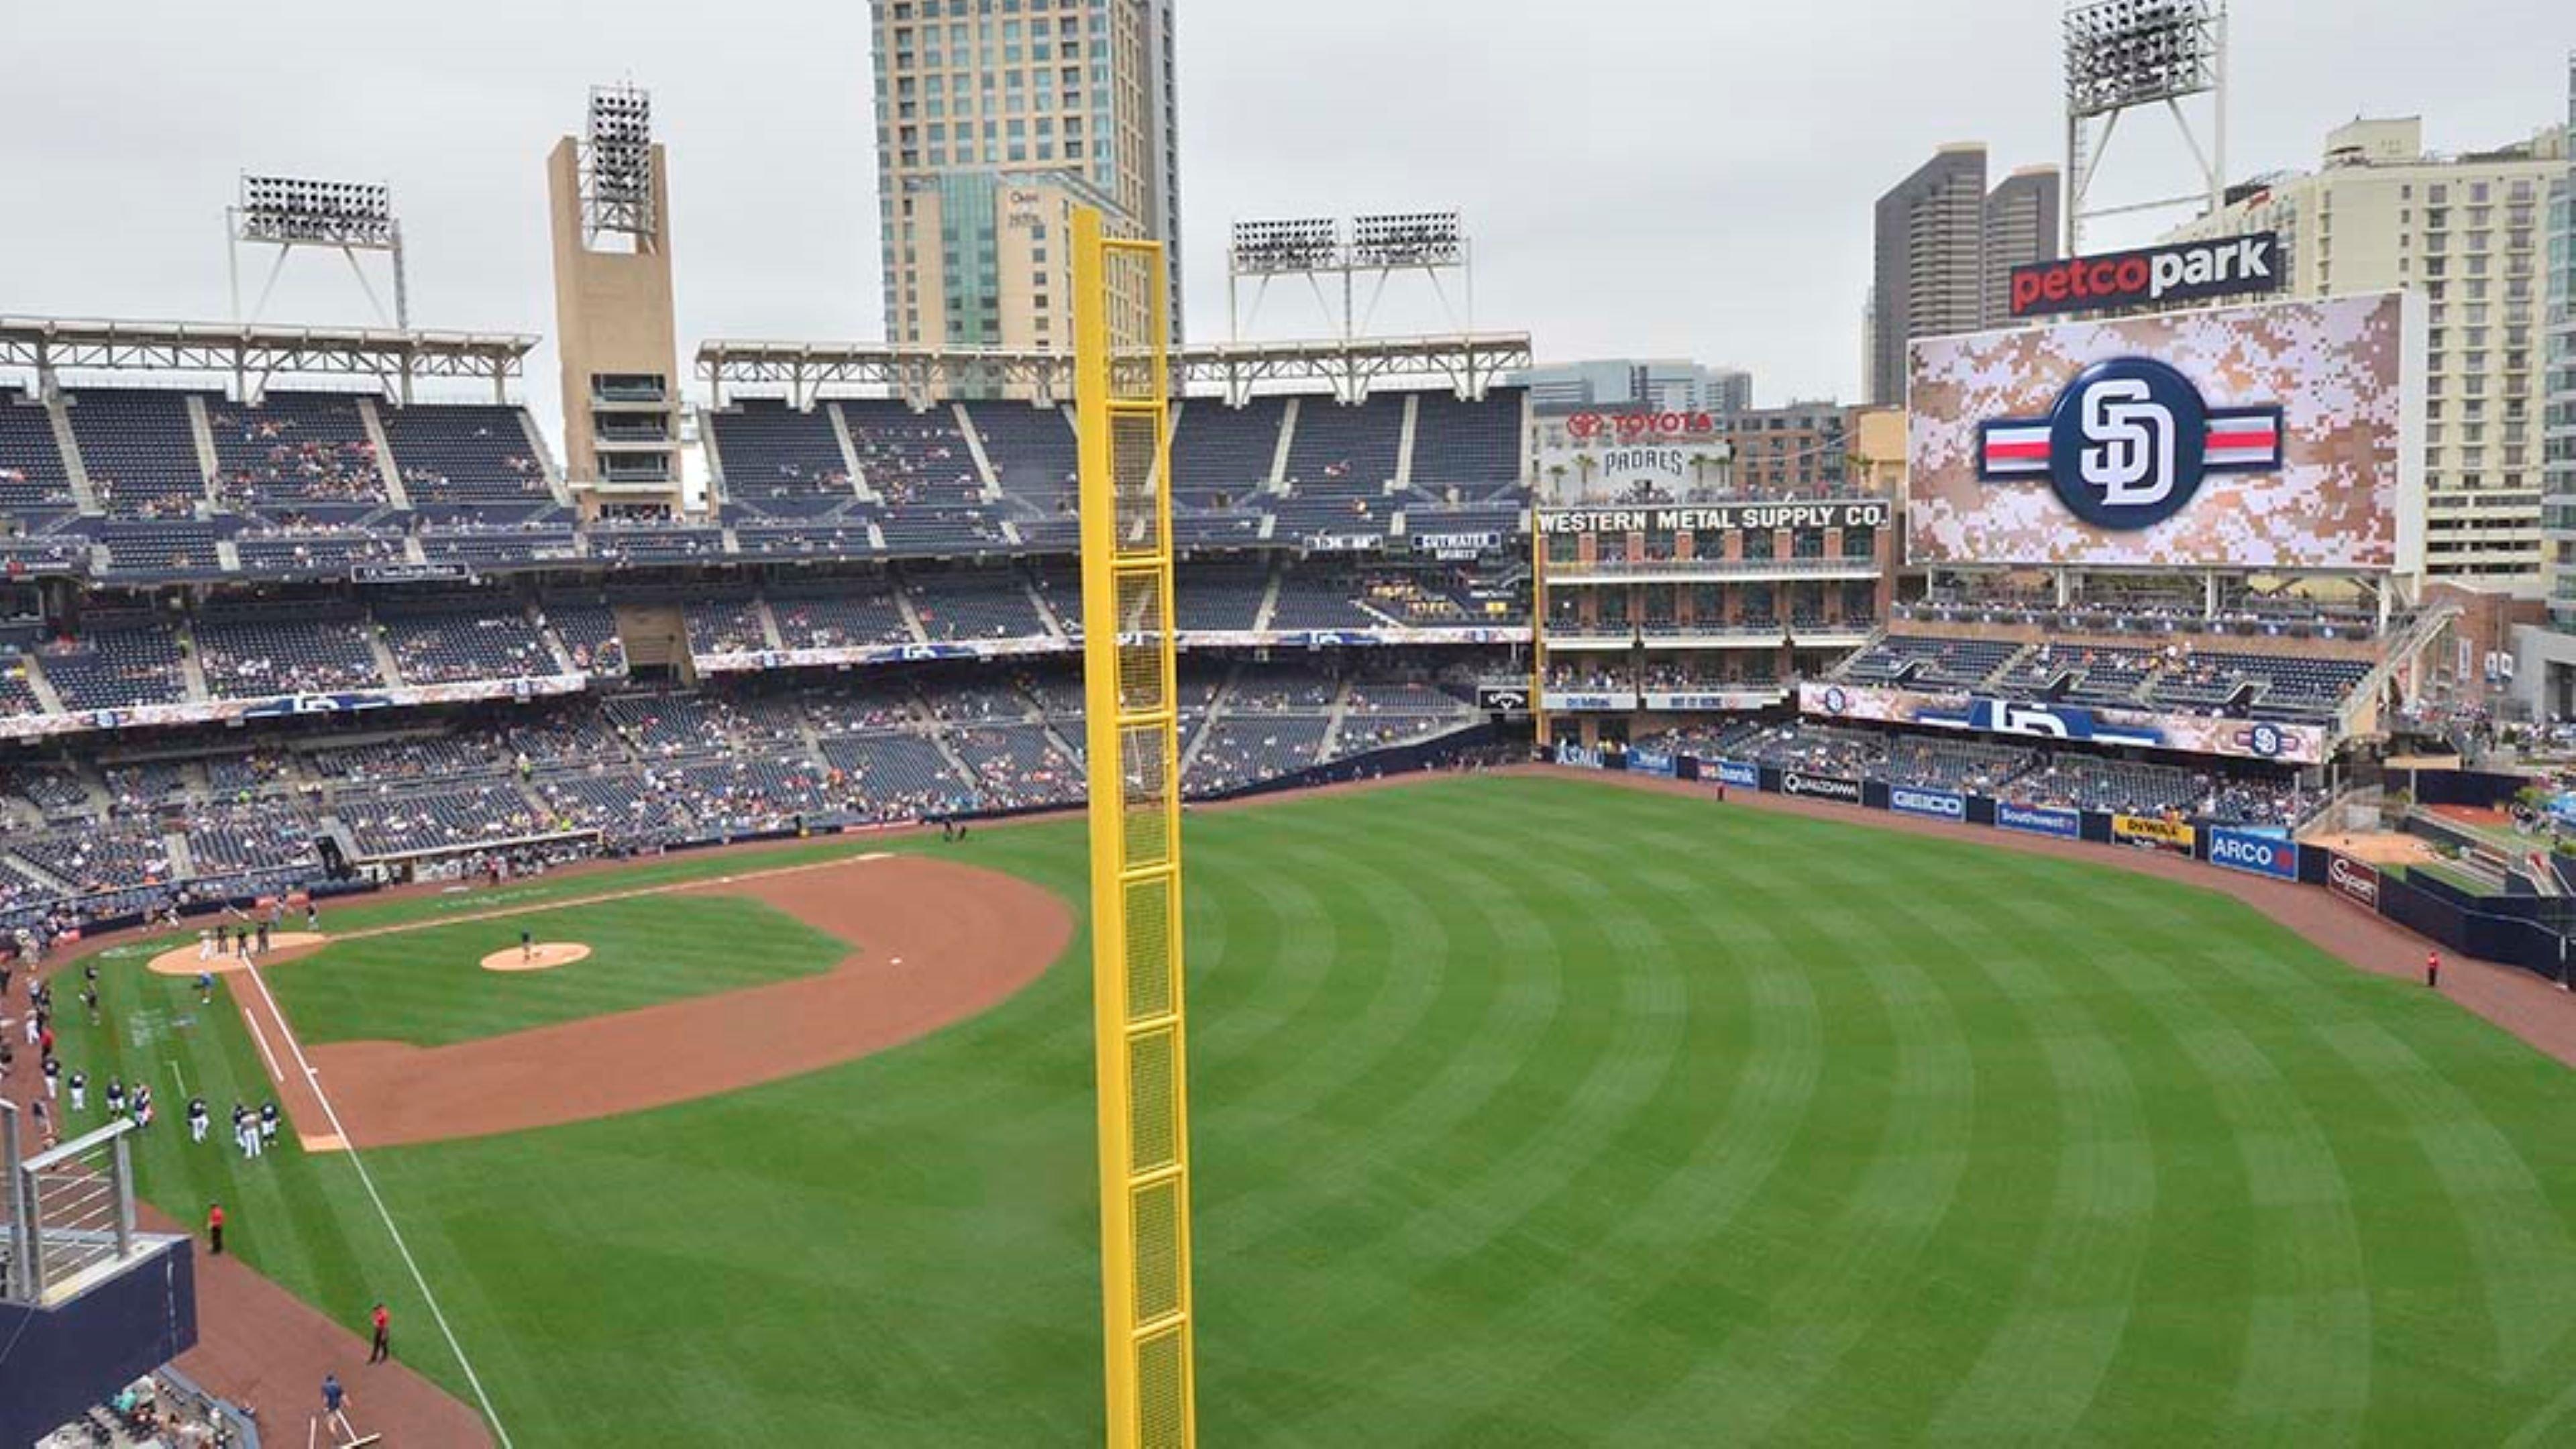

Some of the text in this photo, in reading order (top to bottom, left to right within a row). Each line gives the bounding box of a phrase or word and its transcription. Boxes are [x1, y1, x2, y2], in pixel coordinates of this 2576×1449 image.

[1611, 413, 1713, 433] TOYOTA
[1605, 448, 1683, 477] PADRES
[1539, 506, 1887, 533] WESTERN METAL SUPPLY CO.
[1893, 790, 1960, 814] GEICO
[2001, 808, 2065, 829] Southwest
[2212, 837, 2272, 865] ARCO
